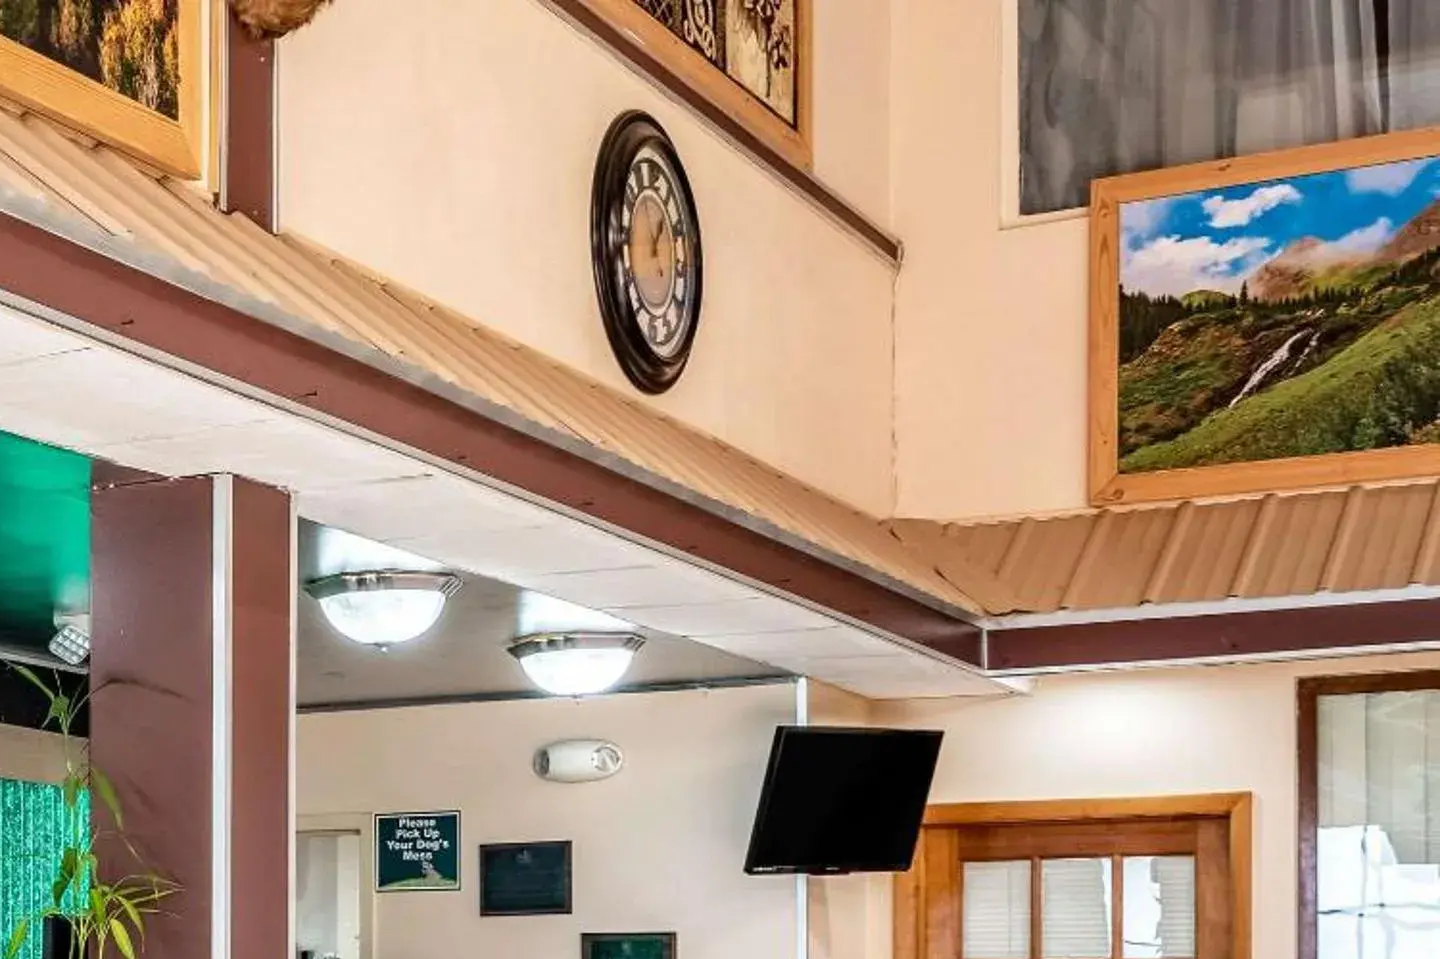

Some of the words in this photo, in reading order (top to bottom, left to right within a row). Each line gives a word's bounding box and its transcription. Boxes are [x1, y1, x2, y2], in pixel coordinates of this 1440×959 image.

[399, 818, 436, 828] Please
[396, 828, 420, 839] Pick
[424, 828, 440, 839] Up
[387, 840, 413, 850] Your
[416, 838, 450, 851] Dog's
